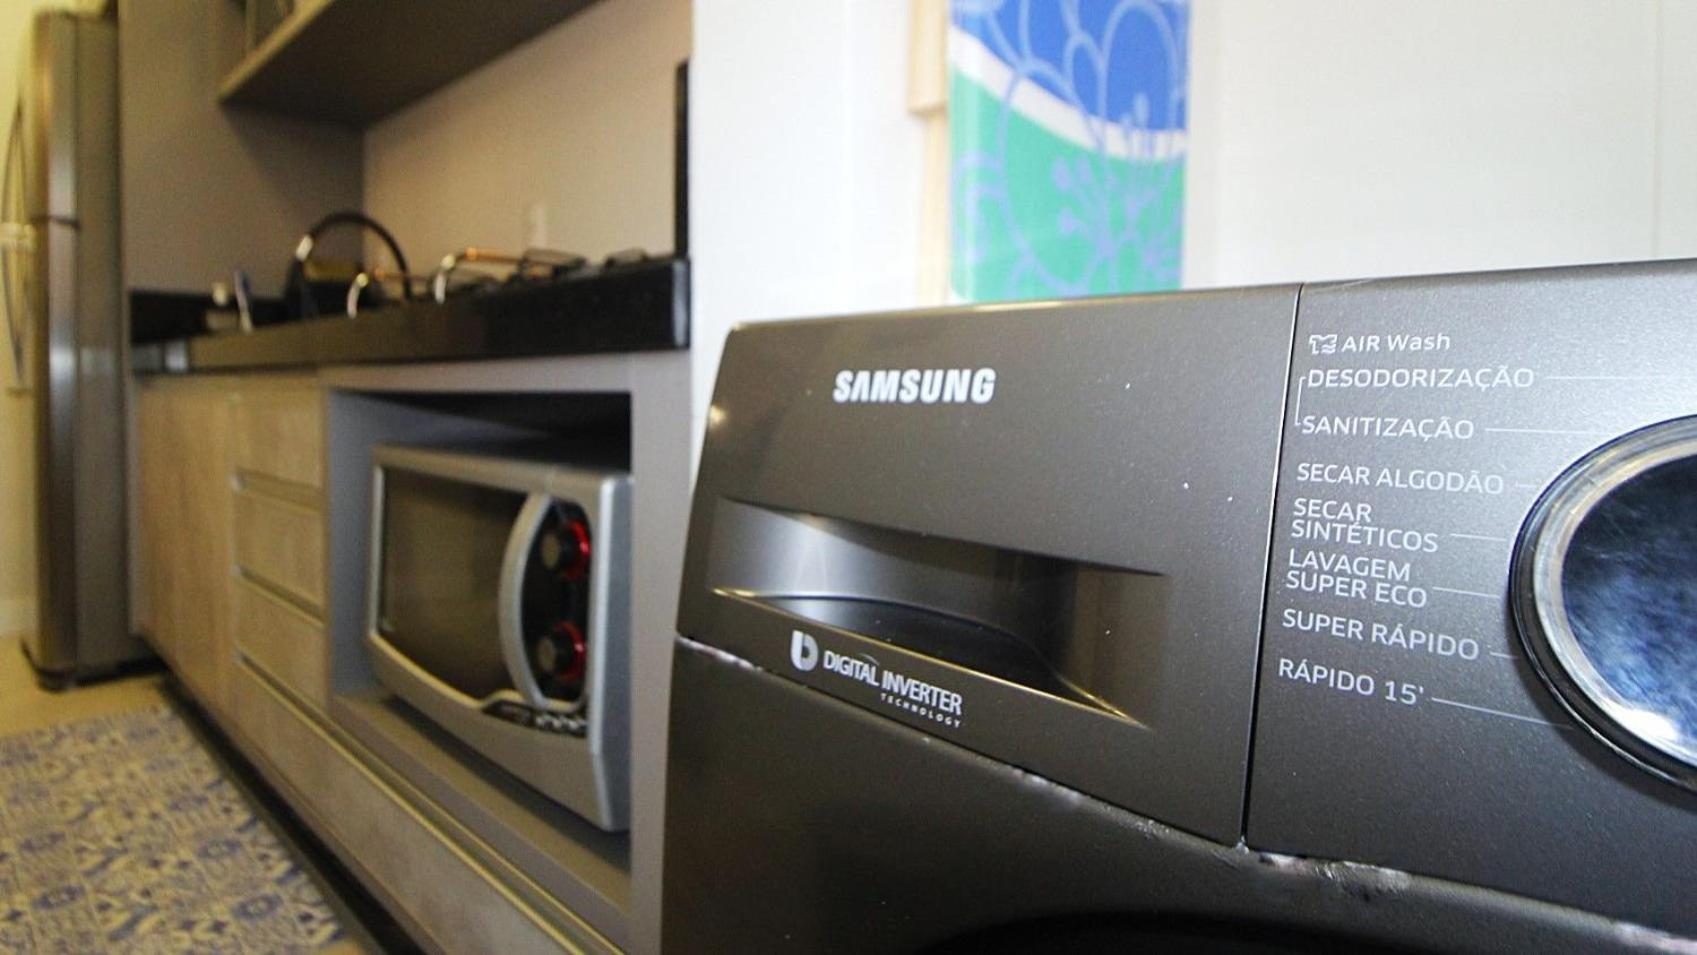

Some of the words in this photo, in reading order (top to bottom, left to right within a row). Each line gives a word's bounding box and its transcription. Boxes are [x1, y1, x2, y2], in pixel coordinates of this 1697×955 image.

[1342, 334, 1380, 351] AIR
[1387, 333, 1451, 350] Wash
[833, 368, 996, 403] SAMSUNG
[1307, 367, 1535, 393] DESODORIZAÇÃO
[1302, 415, 1475, 441] SANITIZAÇÃO
[1297, 463, 1370, 486] SECAR
[1376, 469, 1504, 495] ALGODÃO
[1293, 498, 1372, 522] SECAR
[1291, 519, 1439, 553] SINTÉTICOS
[1288, 549, 1411, 582] LAVAGEM
[1286, 570, 1368, 599] SUPER
[1375, 582, 1428, 608] ECO
[1282, 608, 1363, 640] SUPER
[1371, 623, 1479, 660] RÁPIDO
[823, 651, 880, 686] DIGITAL
[883, 670, 963, 715] INVERTER
[1278, 658, 1375, 696] RÁPIDO
[881, 693, 961, 728] TECHNOLOGY
